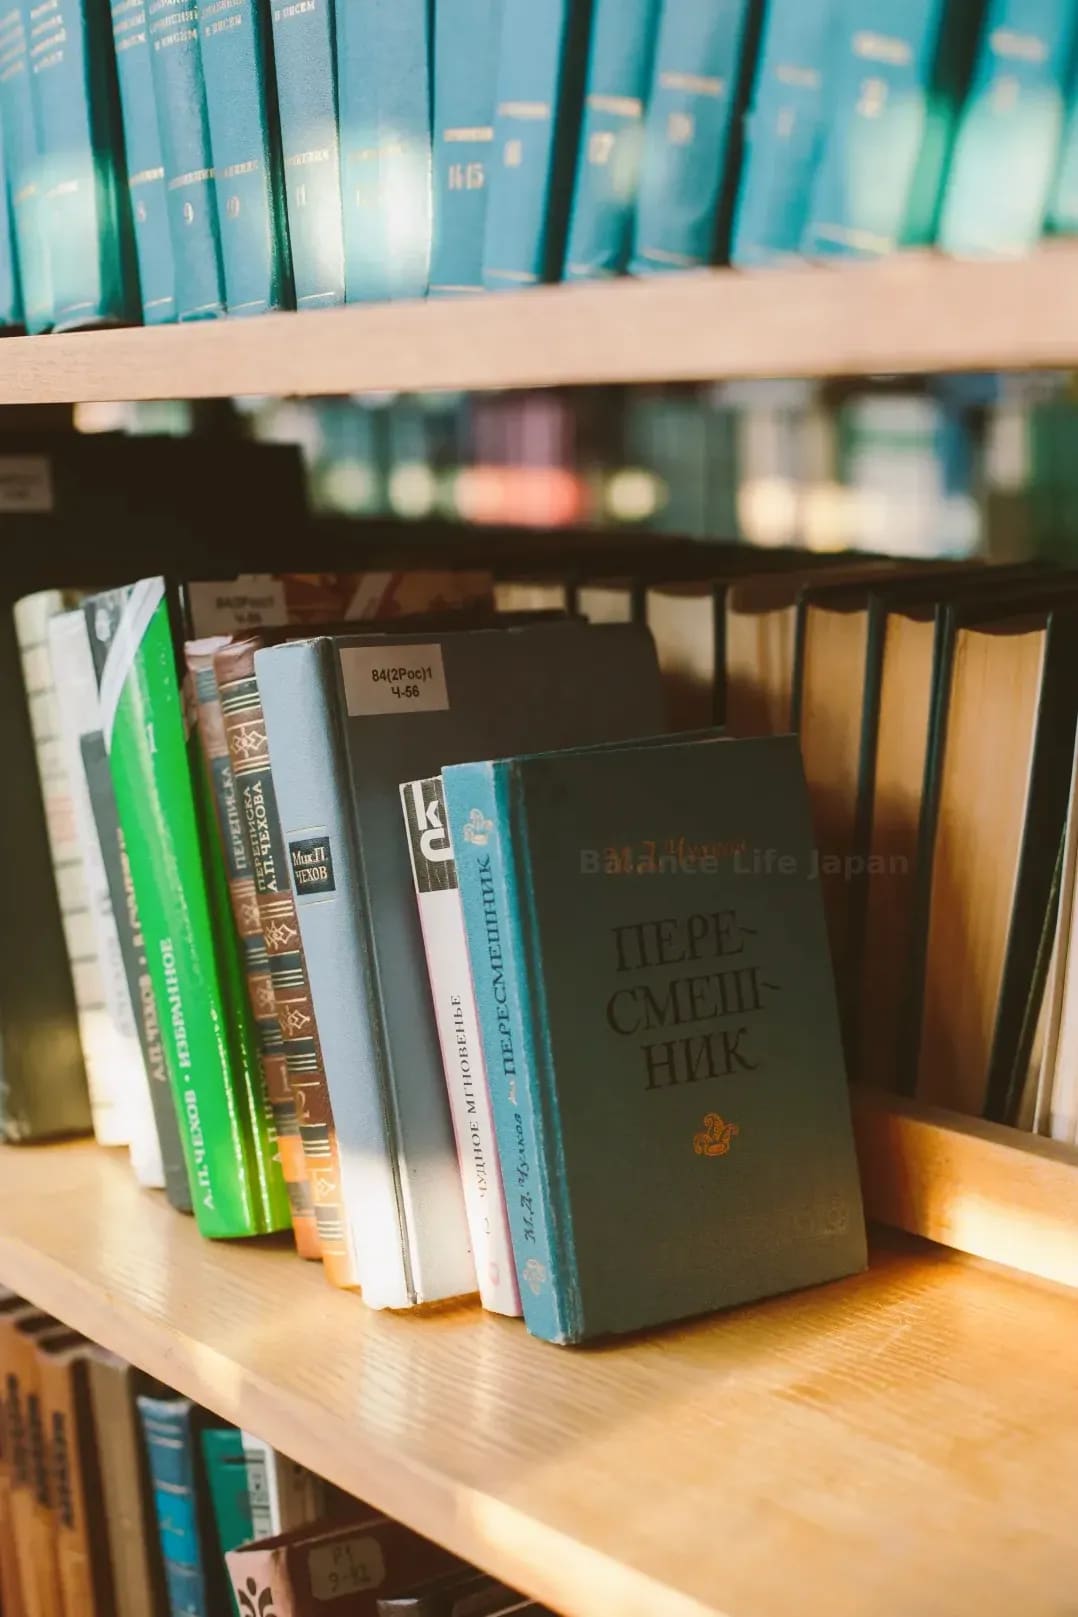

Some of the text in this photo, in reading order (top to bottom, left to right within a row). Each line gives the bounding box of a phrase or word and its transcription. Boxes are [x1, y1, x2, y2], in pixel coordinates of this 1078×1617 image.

[371, 666, 433, 683] 84(2Рос)1
[391, 684, 420, 699] Ч-56
[221, 766, 248, 871] ПЕРЕПИСКА
[242, 786, 267, 892] ПЕРЕПИСКА
[295, 865, 328, 885] ЧЕХОВ
[477, 854, 517, 1076] ПЕРЕСМЕШНИК
[451, 995, 477, 1114] МГНОВЕНЬЕ
[640, 1026, 762, 1092] НИК
